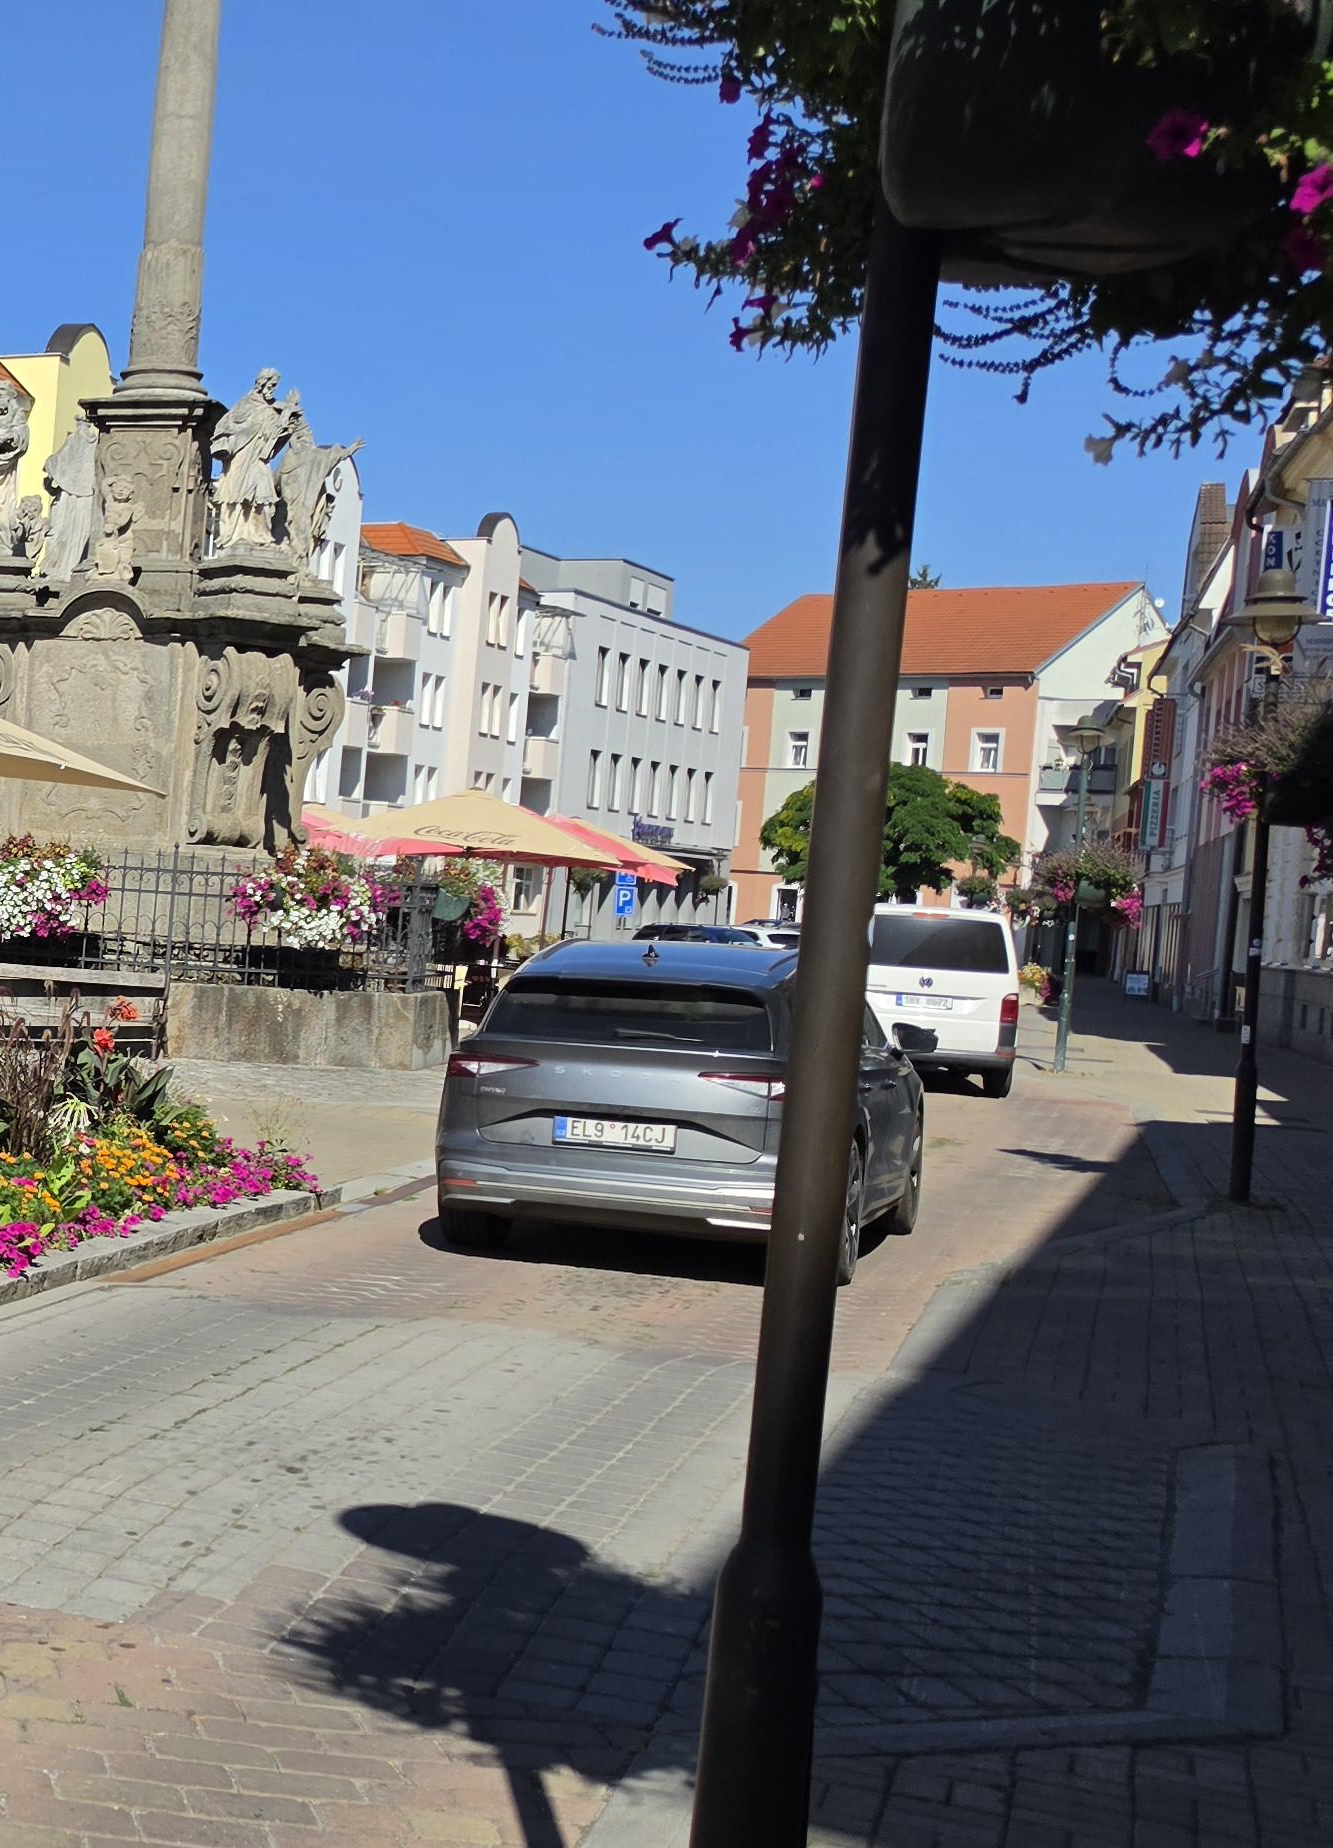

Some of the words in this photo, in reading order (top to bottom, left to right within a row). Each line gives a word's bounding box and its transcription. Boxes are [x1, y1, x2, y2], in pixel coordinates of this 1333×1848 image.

[1149, 789, 1161, 838] PIZZERIA
[413, 825, 519, 846] Coca-Cola
[619, 890, 631, 907] P
[570, 1119, 605, 1139] EL9
[620, 1123, 666, 1144] 14CJ
